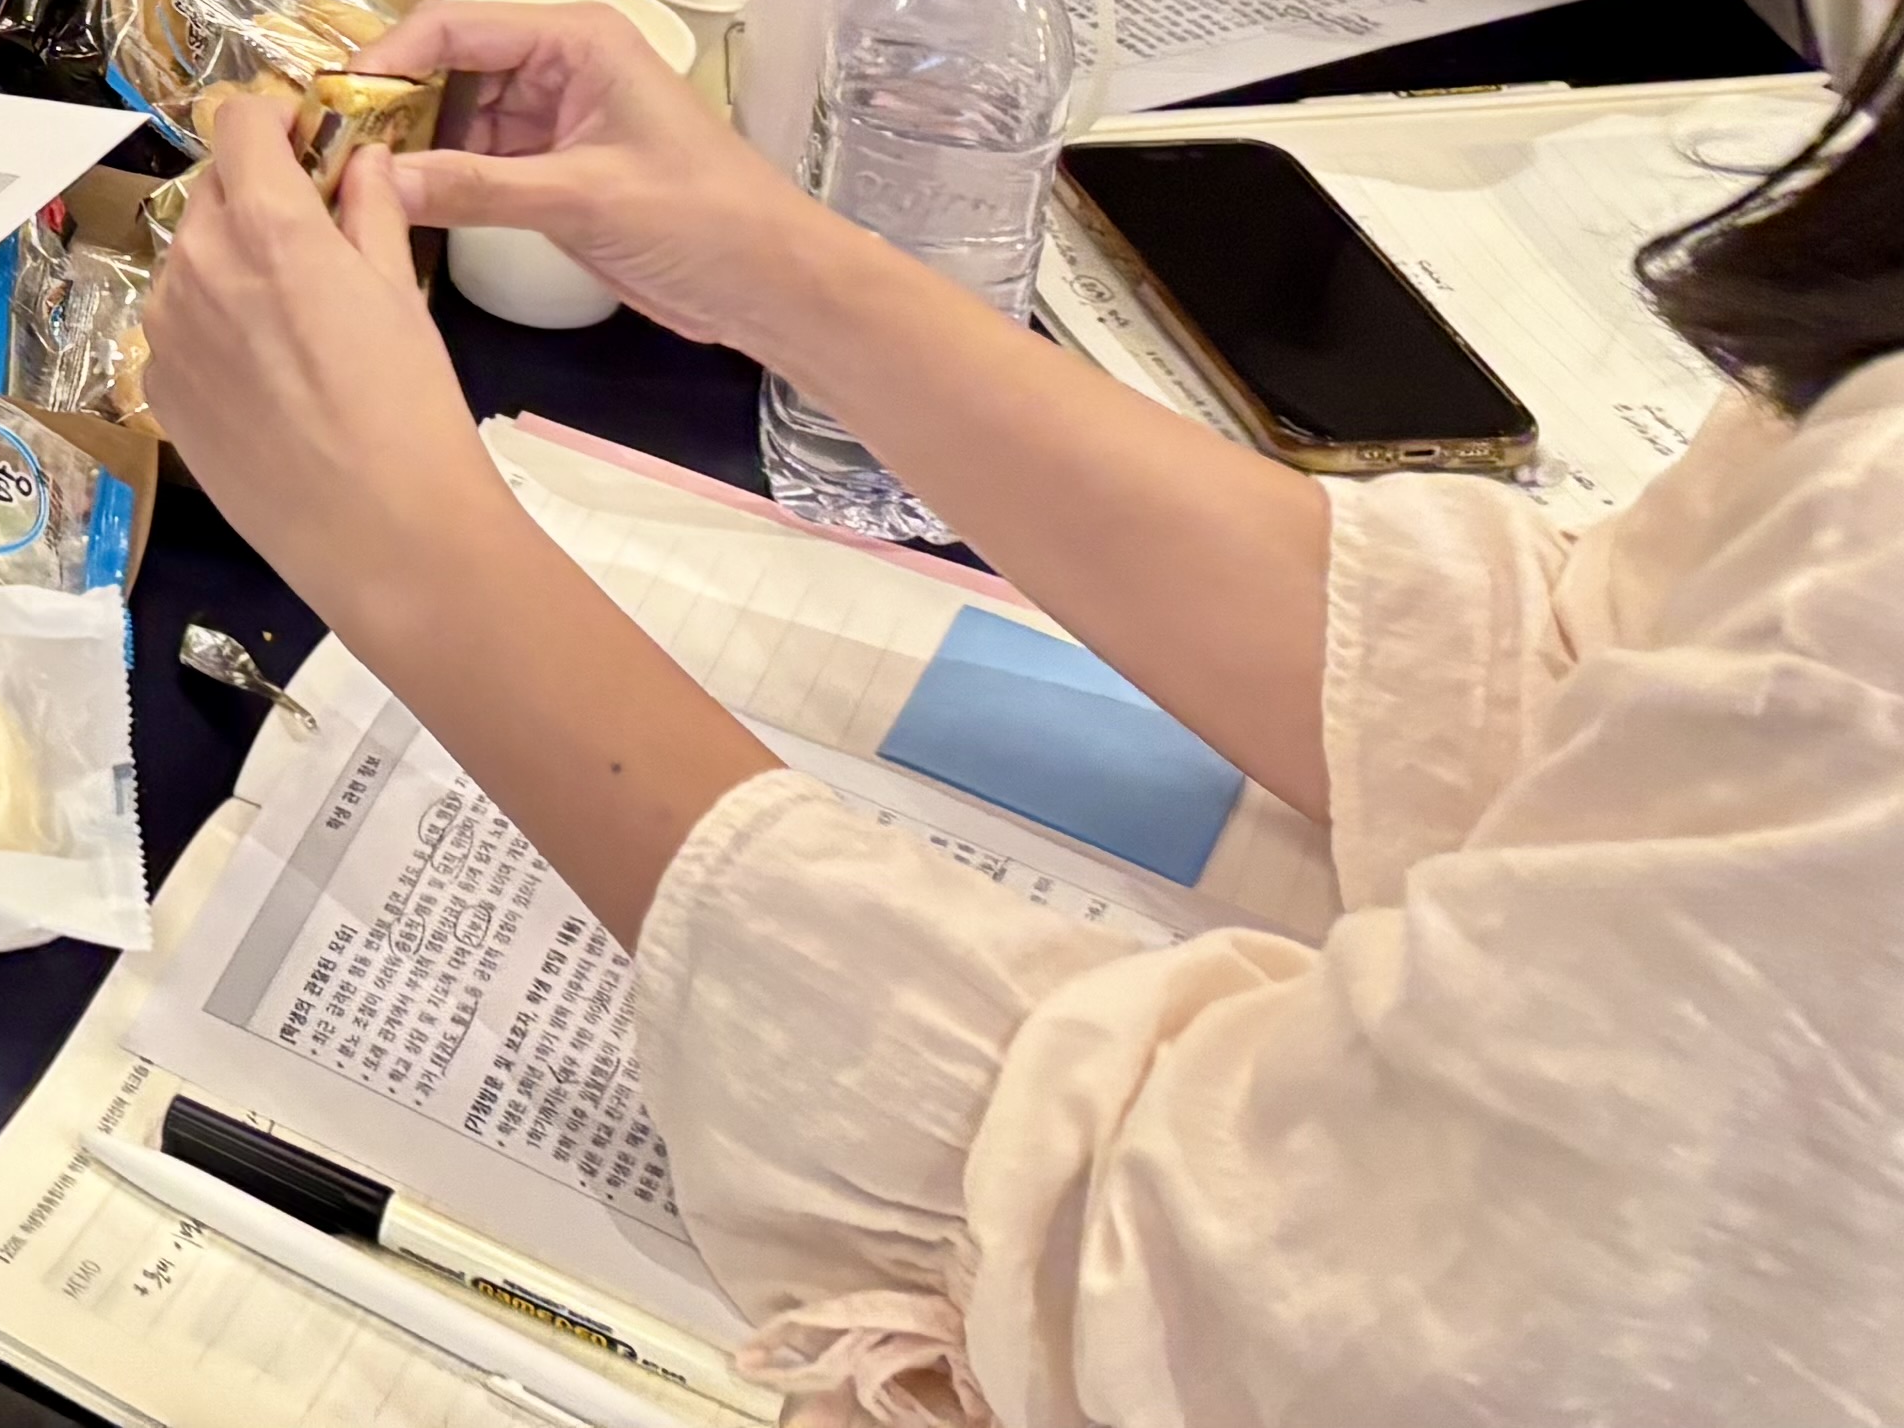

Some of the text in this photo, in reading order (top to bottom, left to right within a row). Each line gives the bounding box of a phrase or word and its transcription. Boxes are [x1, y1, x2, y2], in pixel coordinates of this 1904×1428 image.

[326, 756, 381, 830] 학생 관련 정보
[280, 998, 315, 1045] [학생의
[328, 924, 358, 954] 모습]
[464, 1076, 503, 1135] [가정방문
[526, 978, 552, 1004] 학생
